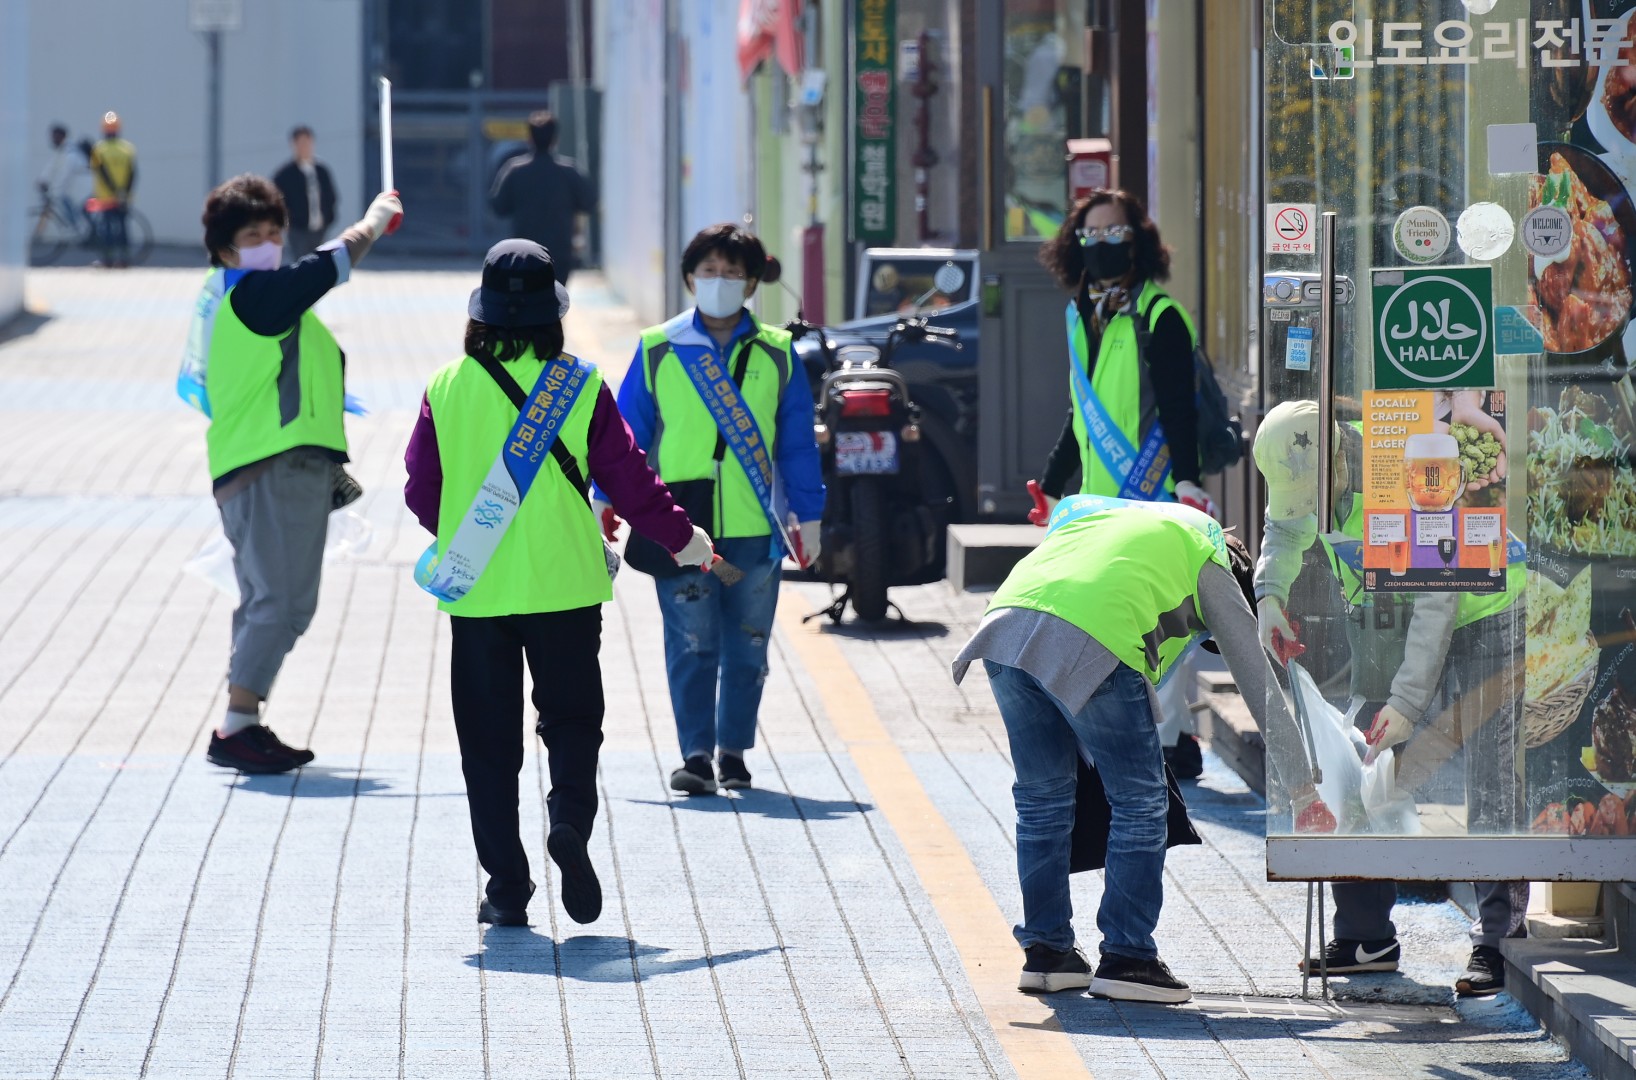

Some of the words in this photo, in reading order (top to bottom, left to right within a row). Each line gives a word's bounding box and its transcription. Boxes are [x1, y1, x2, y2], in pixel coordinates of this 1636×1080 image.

[1328, 18, 1633, 68] 인도요리전문
[1406, 219, 1438, 228] Muslim
[1532, 218, 1563, 230] WELCOME
[1406, 228, 1440, 238] Friendly
[1271, 243, 1311, 251] 금연구역
[1390, 298, 1478, 341] حلال
[1400, 344, 1469, 362] HALAL
[1370, 398, 1416, 408] LOCALLY
[1370, 412, 1420, 421] CRAFTED
[1370, 425, 1407, 435] CZECH
[509, 423, 535, 458] 구민
[1370, 439, 1405, 448] LAGER
[1425, 466, 1439, 486] 993
